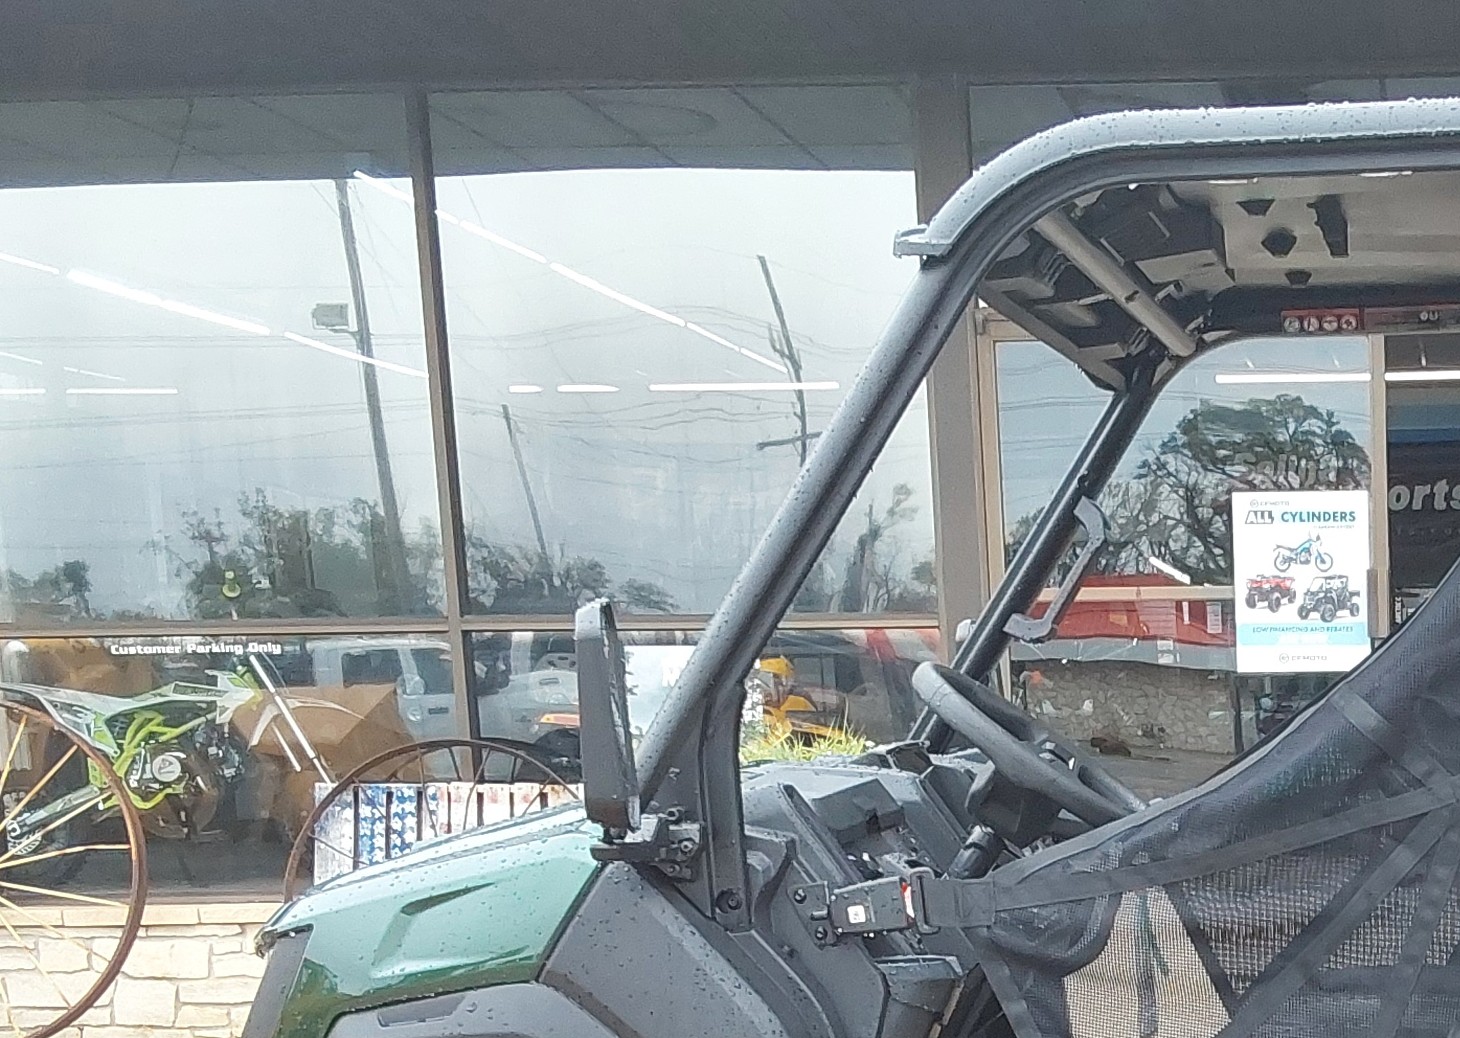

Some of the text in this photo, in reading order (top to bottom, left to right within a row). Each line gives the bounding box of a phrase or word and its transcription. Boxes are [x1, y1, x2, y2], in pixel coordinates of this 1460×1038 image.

[1245, 510, 1356, 524] ALL CYLINDERS
[110, 642, 282, 655] Customer Parking Only
